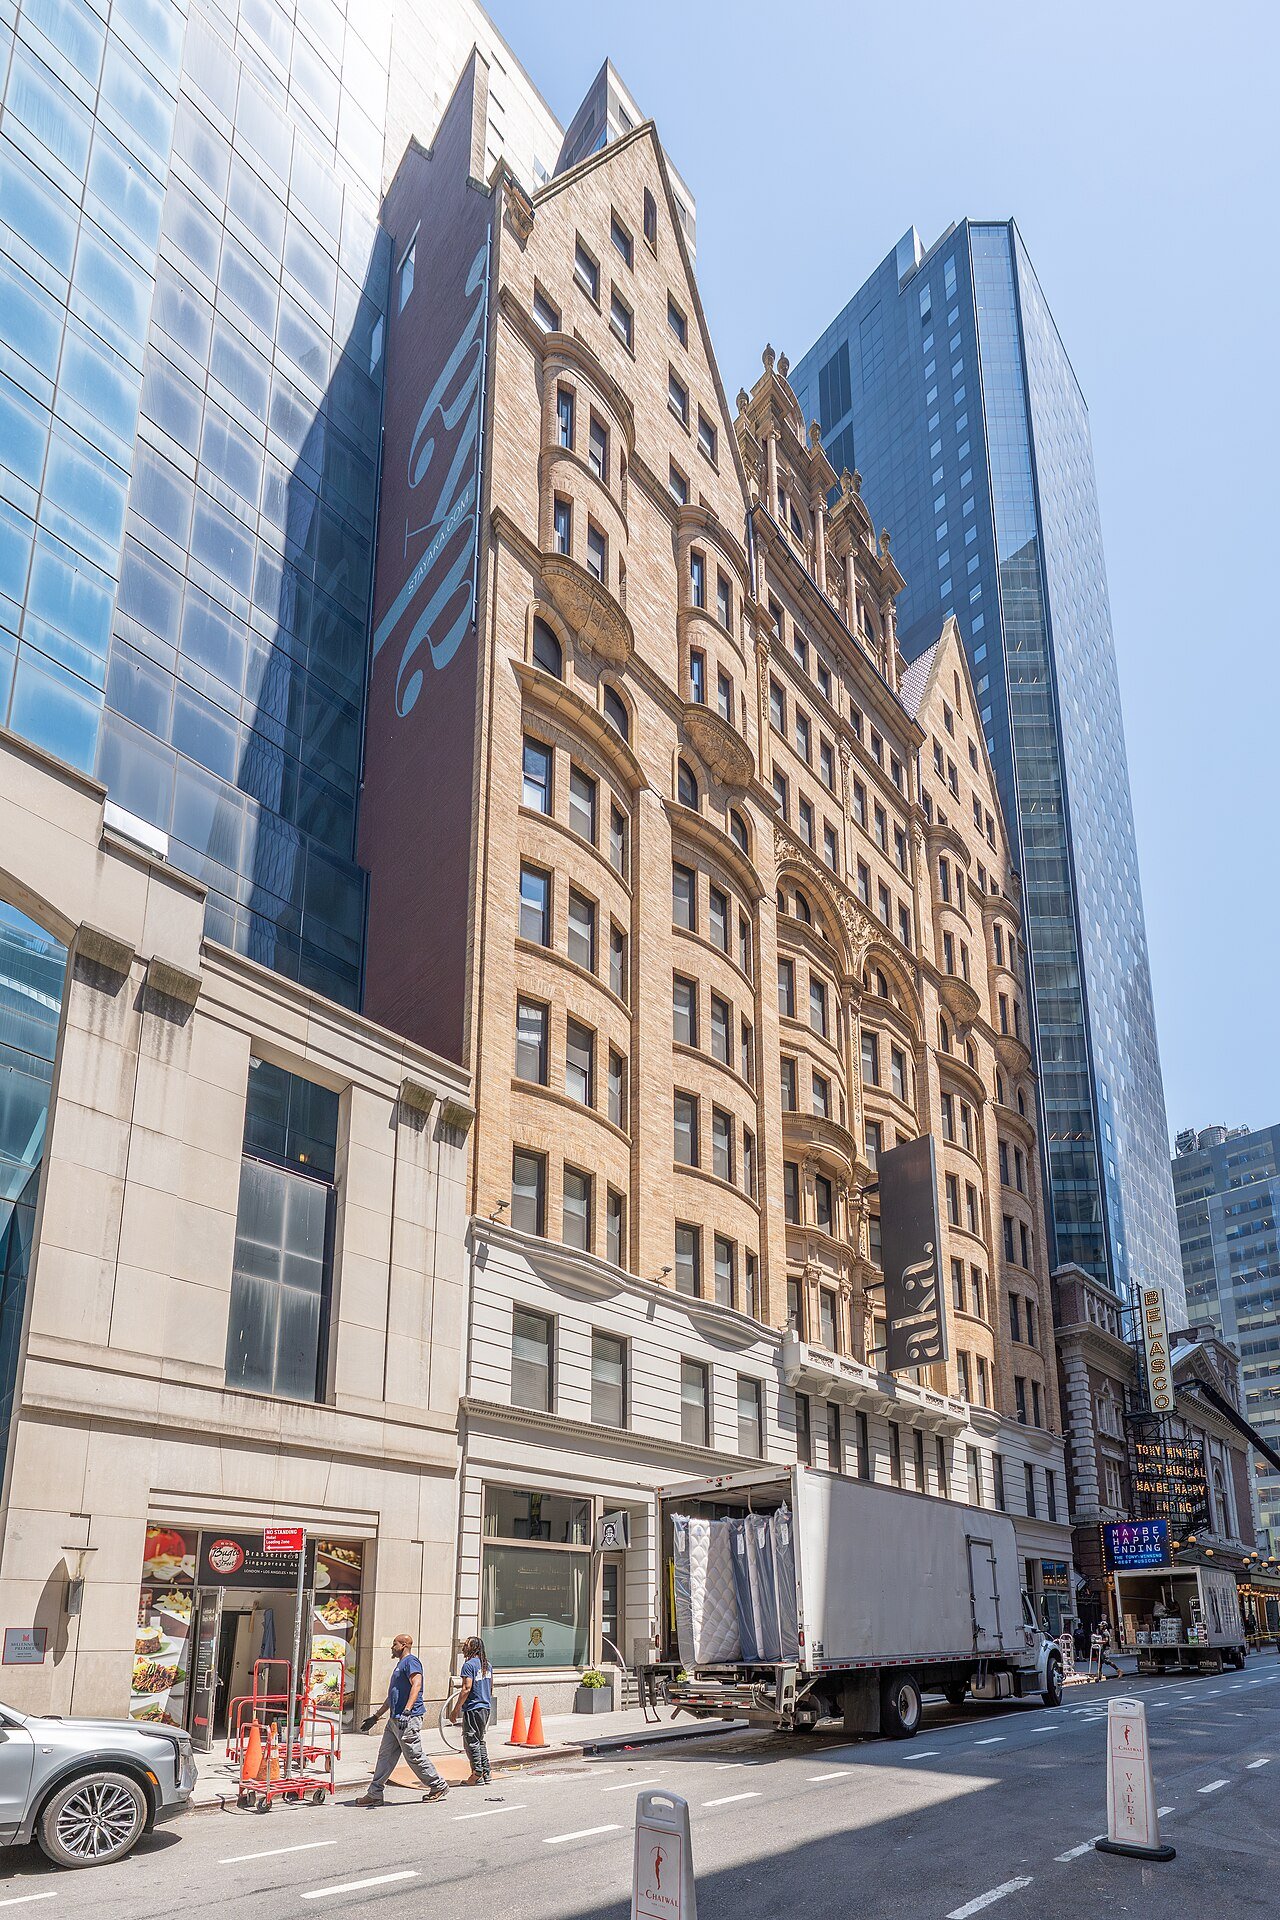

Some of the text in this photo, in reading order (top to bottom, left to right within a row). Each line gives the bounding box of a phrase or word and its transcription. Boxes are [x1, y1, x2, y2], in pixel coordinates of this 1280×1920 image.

[408, 491, 469, 594] STAYAKA.COM
[1144, 1290, 1170, 1409] BELASCO
[1135, 1444, 1161, 1456] TONY
[1137, 1462, 1207, 1478] BEST MUSICAL
[1136, 1480, 1206, 1496] MAYBE HAPPY
[1156, 1501, 1192, 1513] ENDING
[1112, 1526, 1159, 1537] MAYBE
[1113, 1535, 1160, 1546] HAPPY
[212, 1547, 241, 1562] Bugis
[245, 1549, 287, 1560] Brasserie
[1113, 1543, 1161, 1554] ENDING
[216, 1558, 236, 1568] Street
[244, 1559, 286, 1567] Singaporean
[1125, 1772, 1136, 1826] VALET
